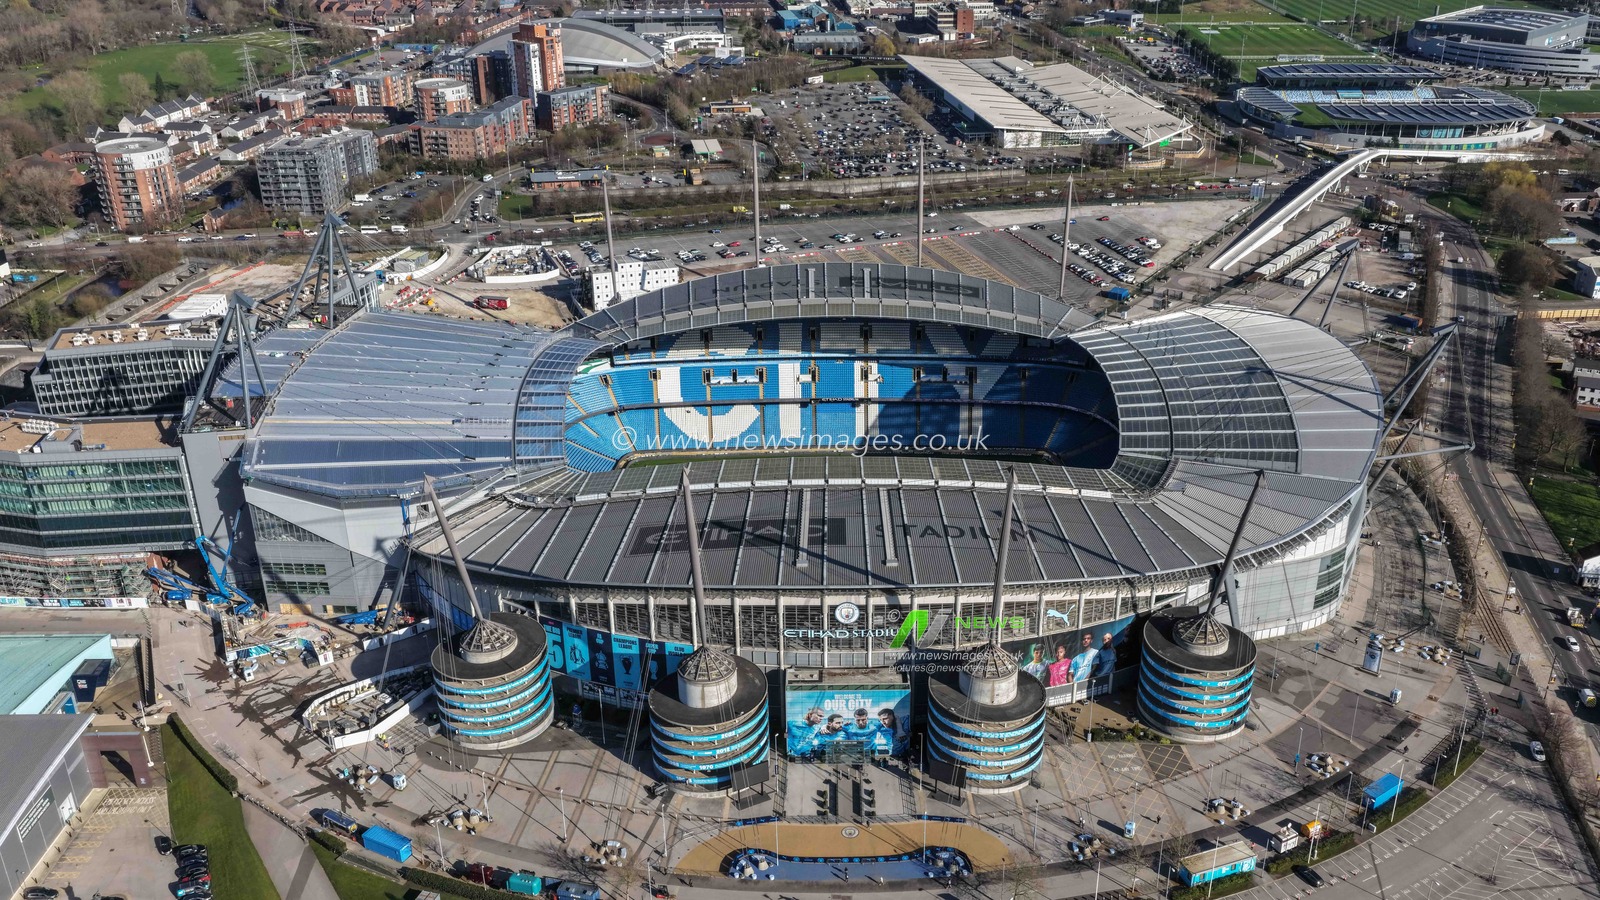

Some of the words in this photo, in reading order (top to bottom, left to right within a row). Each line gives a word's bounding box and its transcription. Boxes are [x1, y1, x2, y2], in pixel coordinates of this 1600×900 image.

[784, 629, 849, 639] ETIHAD
[852, 628, 909, 638] STADIUM
[825, 699, 847, 711] OUR
[848, 699, 872, 711] CITY
